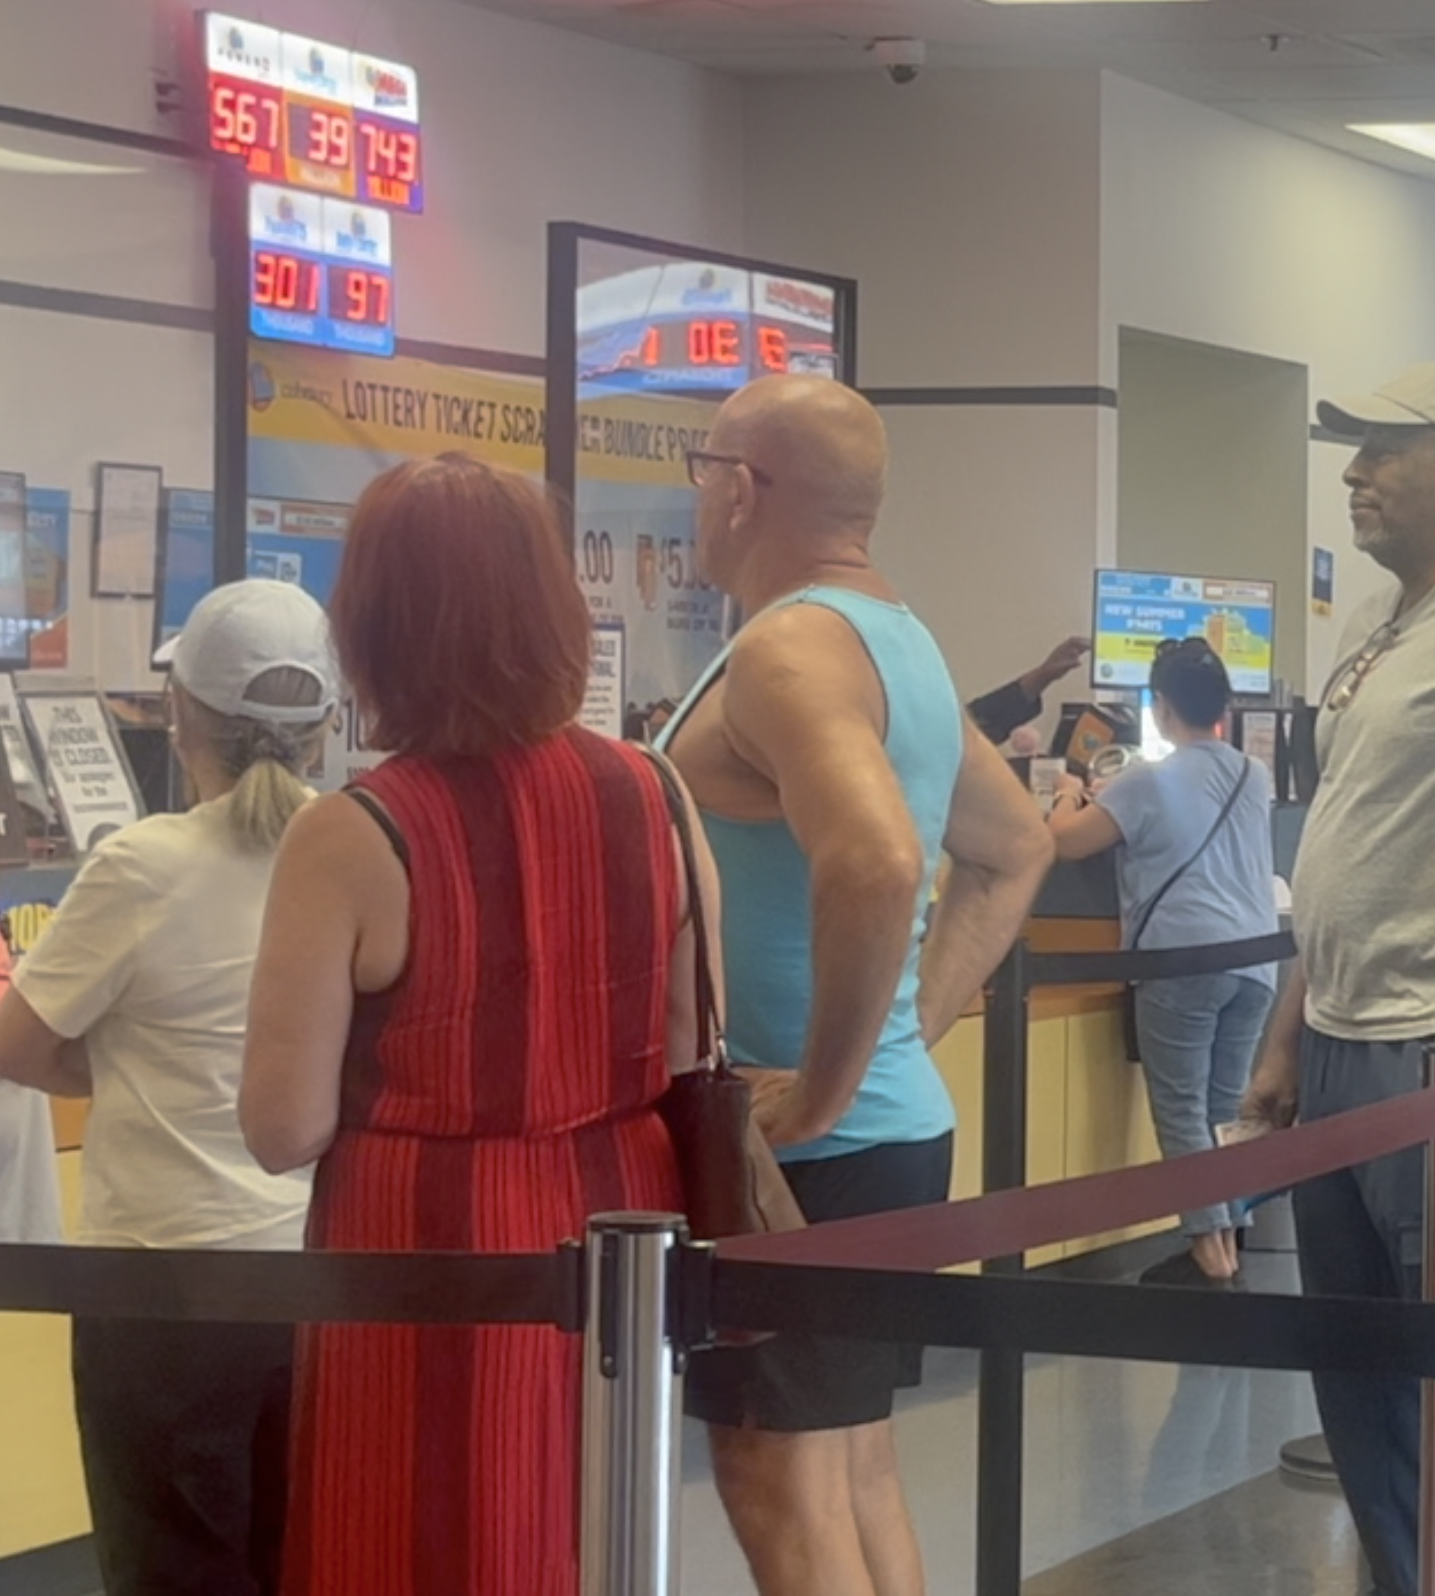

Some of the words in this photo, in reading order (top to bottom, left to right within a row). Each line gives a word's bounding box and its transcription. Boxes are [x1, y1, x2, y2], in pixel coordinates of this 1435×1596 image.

[213, 87, 280, 149] 567
[308, 111, 350, 166] 39
[360, 123, 416, 183] 743
[254, 253, 320, 310] 301
[347, 271, 390, 323] 97
[342, 378, 427, 431] LOTTERY
[432, 392, 497, 441] TICKET
[579, 530, 613, 585] .00
